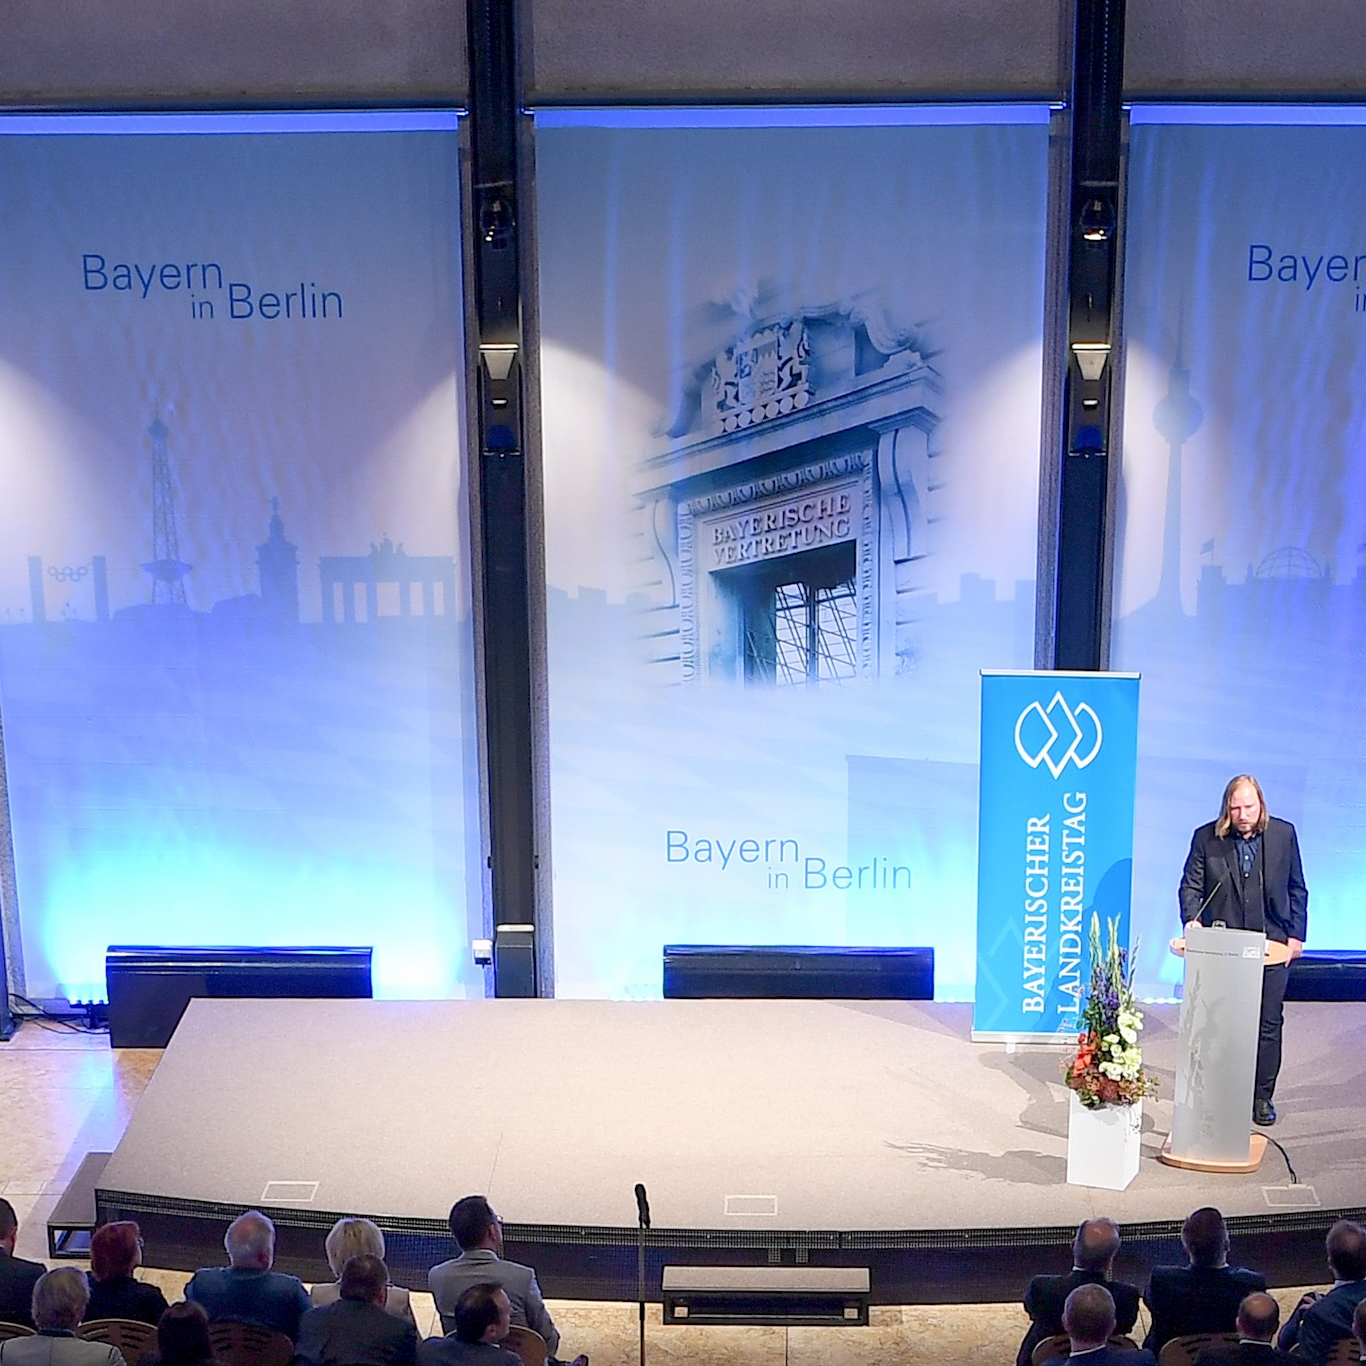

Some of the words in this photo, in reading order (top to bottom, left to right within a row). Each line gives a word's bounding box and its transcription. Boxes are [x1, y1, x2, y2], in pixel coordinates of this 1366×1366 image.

[82, 254, 223, 299] Bayern
[191, 294, 215, 320] in
[229, 283, 343, 319] Berlin
[712, 493, 851, 546] BAYERISCHE
[713, 517, 851, 565] VERTRETUNG
[666, 830, 800, 870] Bayern
[768, 866, 789, 889] in
[804, 857, 912, 890] Berlin
[1022, 812, 1051, 1014] BAYERISCHER
[1057, 791, 1087, 1015] LANDKREISTAG
